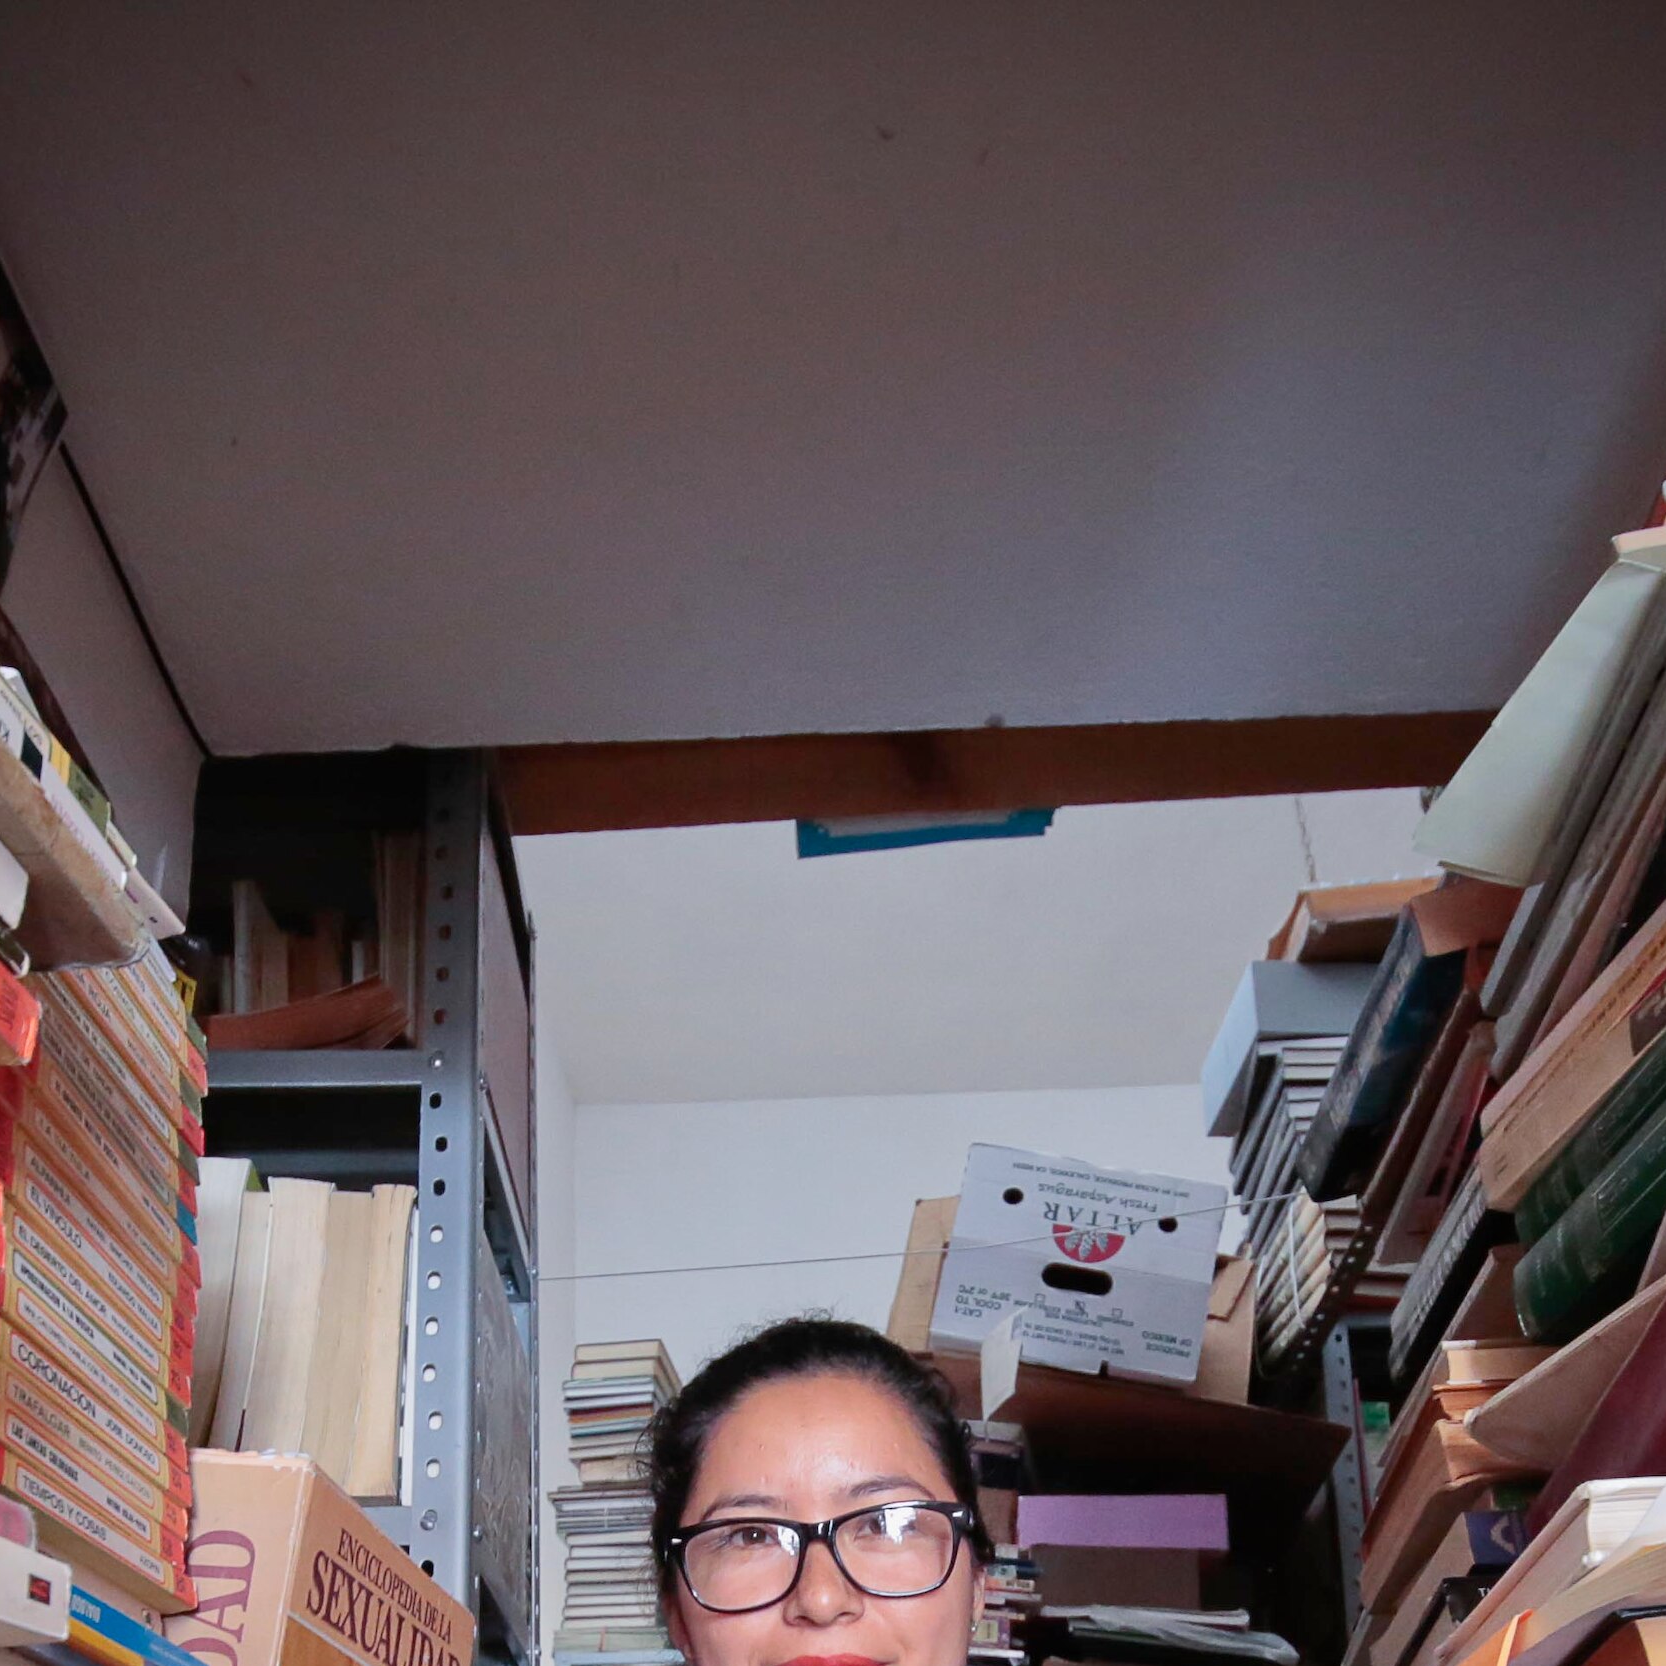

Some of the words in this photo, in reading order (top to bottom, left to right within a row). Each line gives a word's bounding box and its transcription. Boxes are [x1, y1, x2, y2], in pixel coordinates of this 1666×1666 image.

[1038, 1182, 1112, 1204] Asparagus
[1043, 1201, 1143, 1236] ALTAR
[1117, 1195, 1157, 1212] Fresh
[16, 1344, 97, 1417] CORONACION
[12, 1385, 71, 1436] TRAFALGAR
[18, 1475, 67, 1511] TIEMPOS
[72, 1510, 110, 1539] COSAS
[337, 1528, 423, 1613] ENCICLOPEDIA
